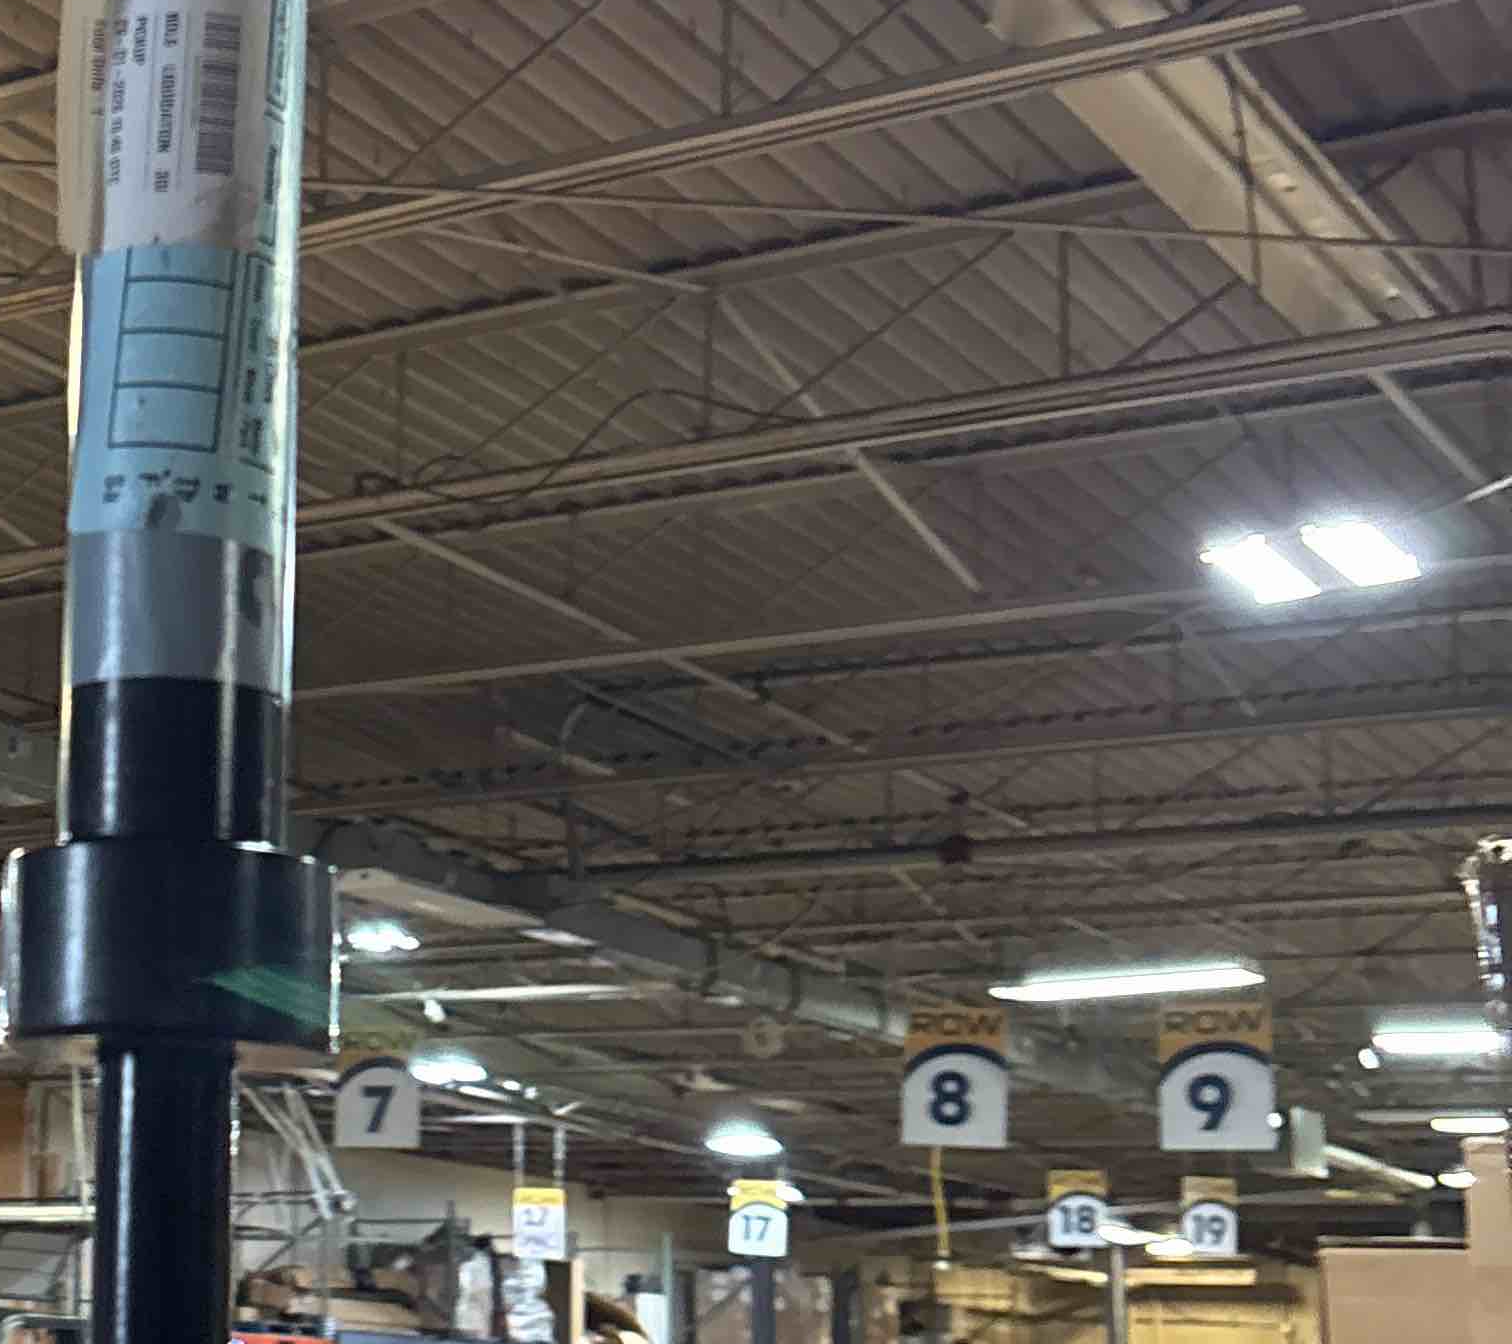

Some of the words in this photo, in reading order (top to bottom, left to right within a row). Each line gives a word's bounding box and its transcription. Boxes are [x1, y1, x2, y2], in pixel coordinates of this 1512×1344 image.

[1165, 1009, 1263, 1034] ROW
[363, 1085, 394, 1133] 7
[929, 1070, 972, 1127] 8
[1187, 1073, 1234, 1132] 9
[743, 1214, 771, 1242] 17
[1059, 1205, 1096, 1234] 18
[1192, 1214, 1227, 1245] 19
